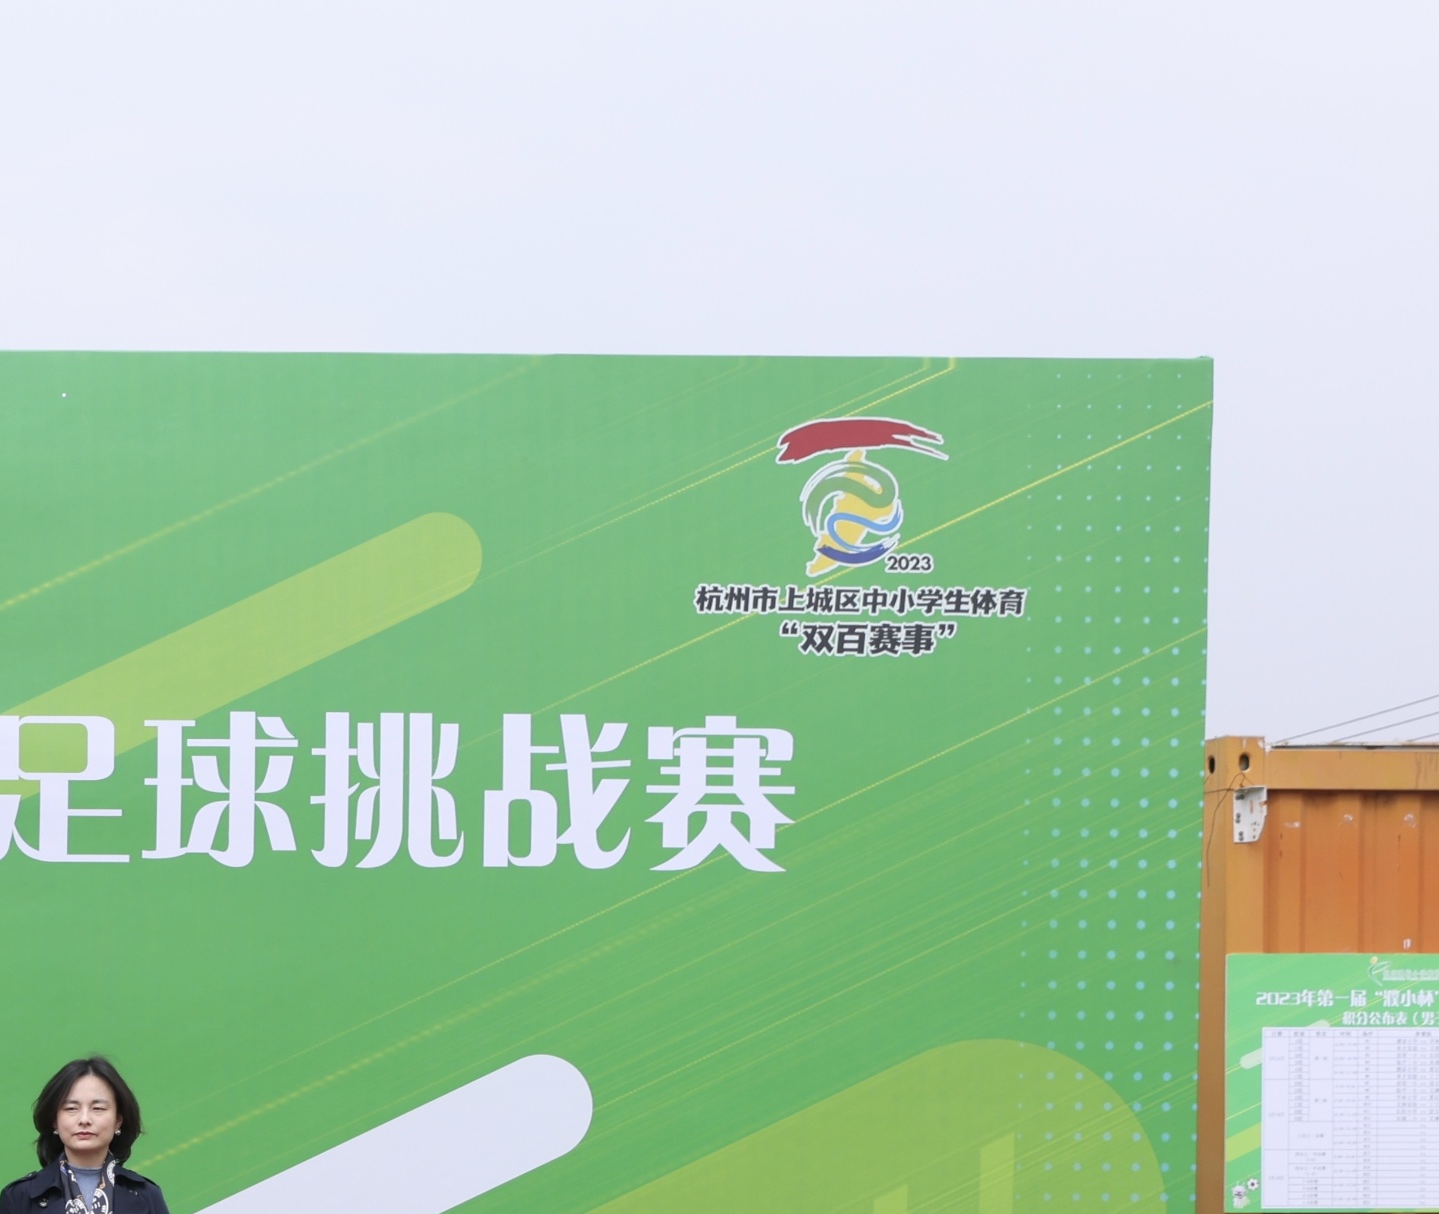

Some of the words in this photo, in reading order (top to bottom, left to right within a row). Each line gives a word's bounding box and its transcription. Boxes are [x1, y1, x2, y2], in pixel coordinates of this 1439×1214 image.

[885, 554, 933, 573] 2023
[695, 585, 1026, 616] 杭州市上城区中小学生体育
[780, 621, 957, 655] “双百赛事”
